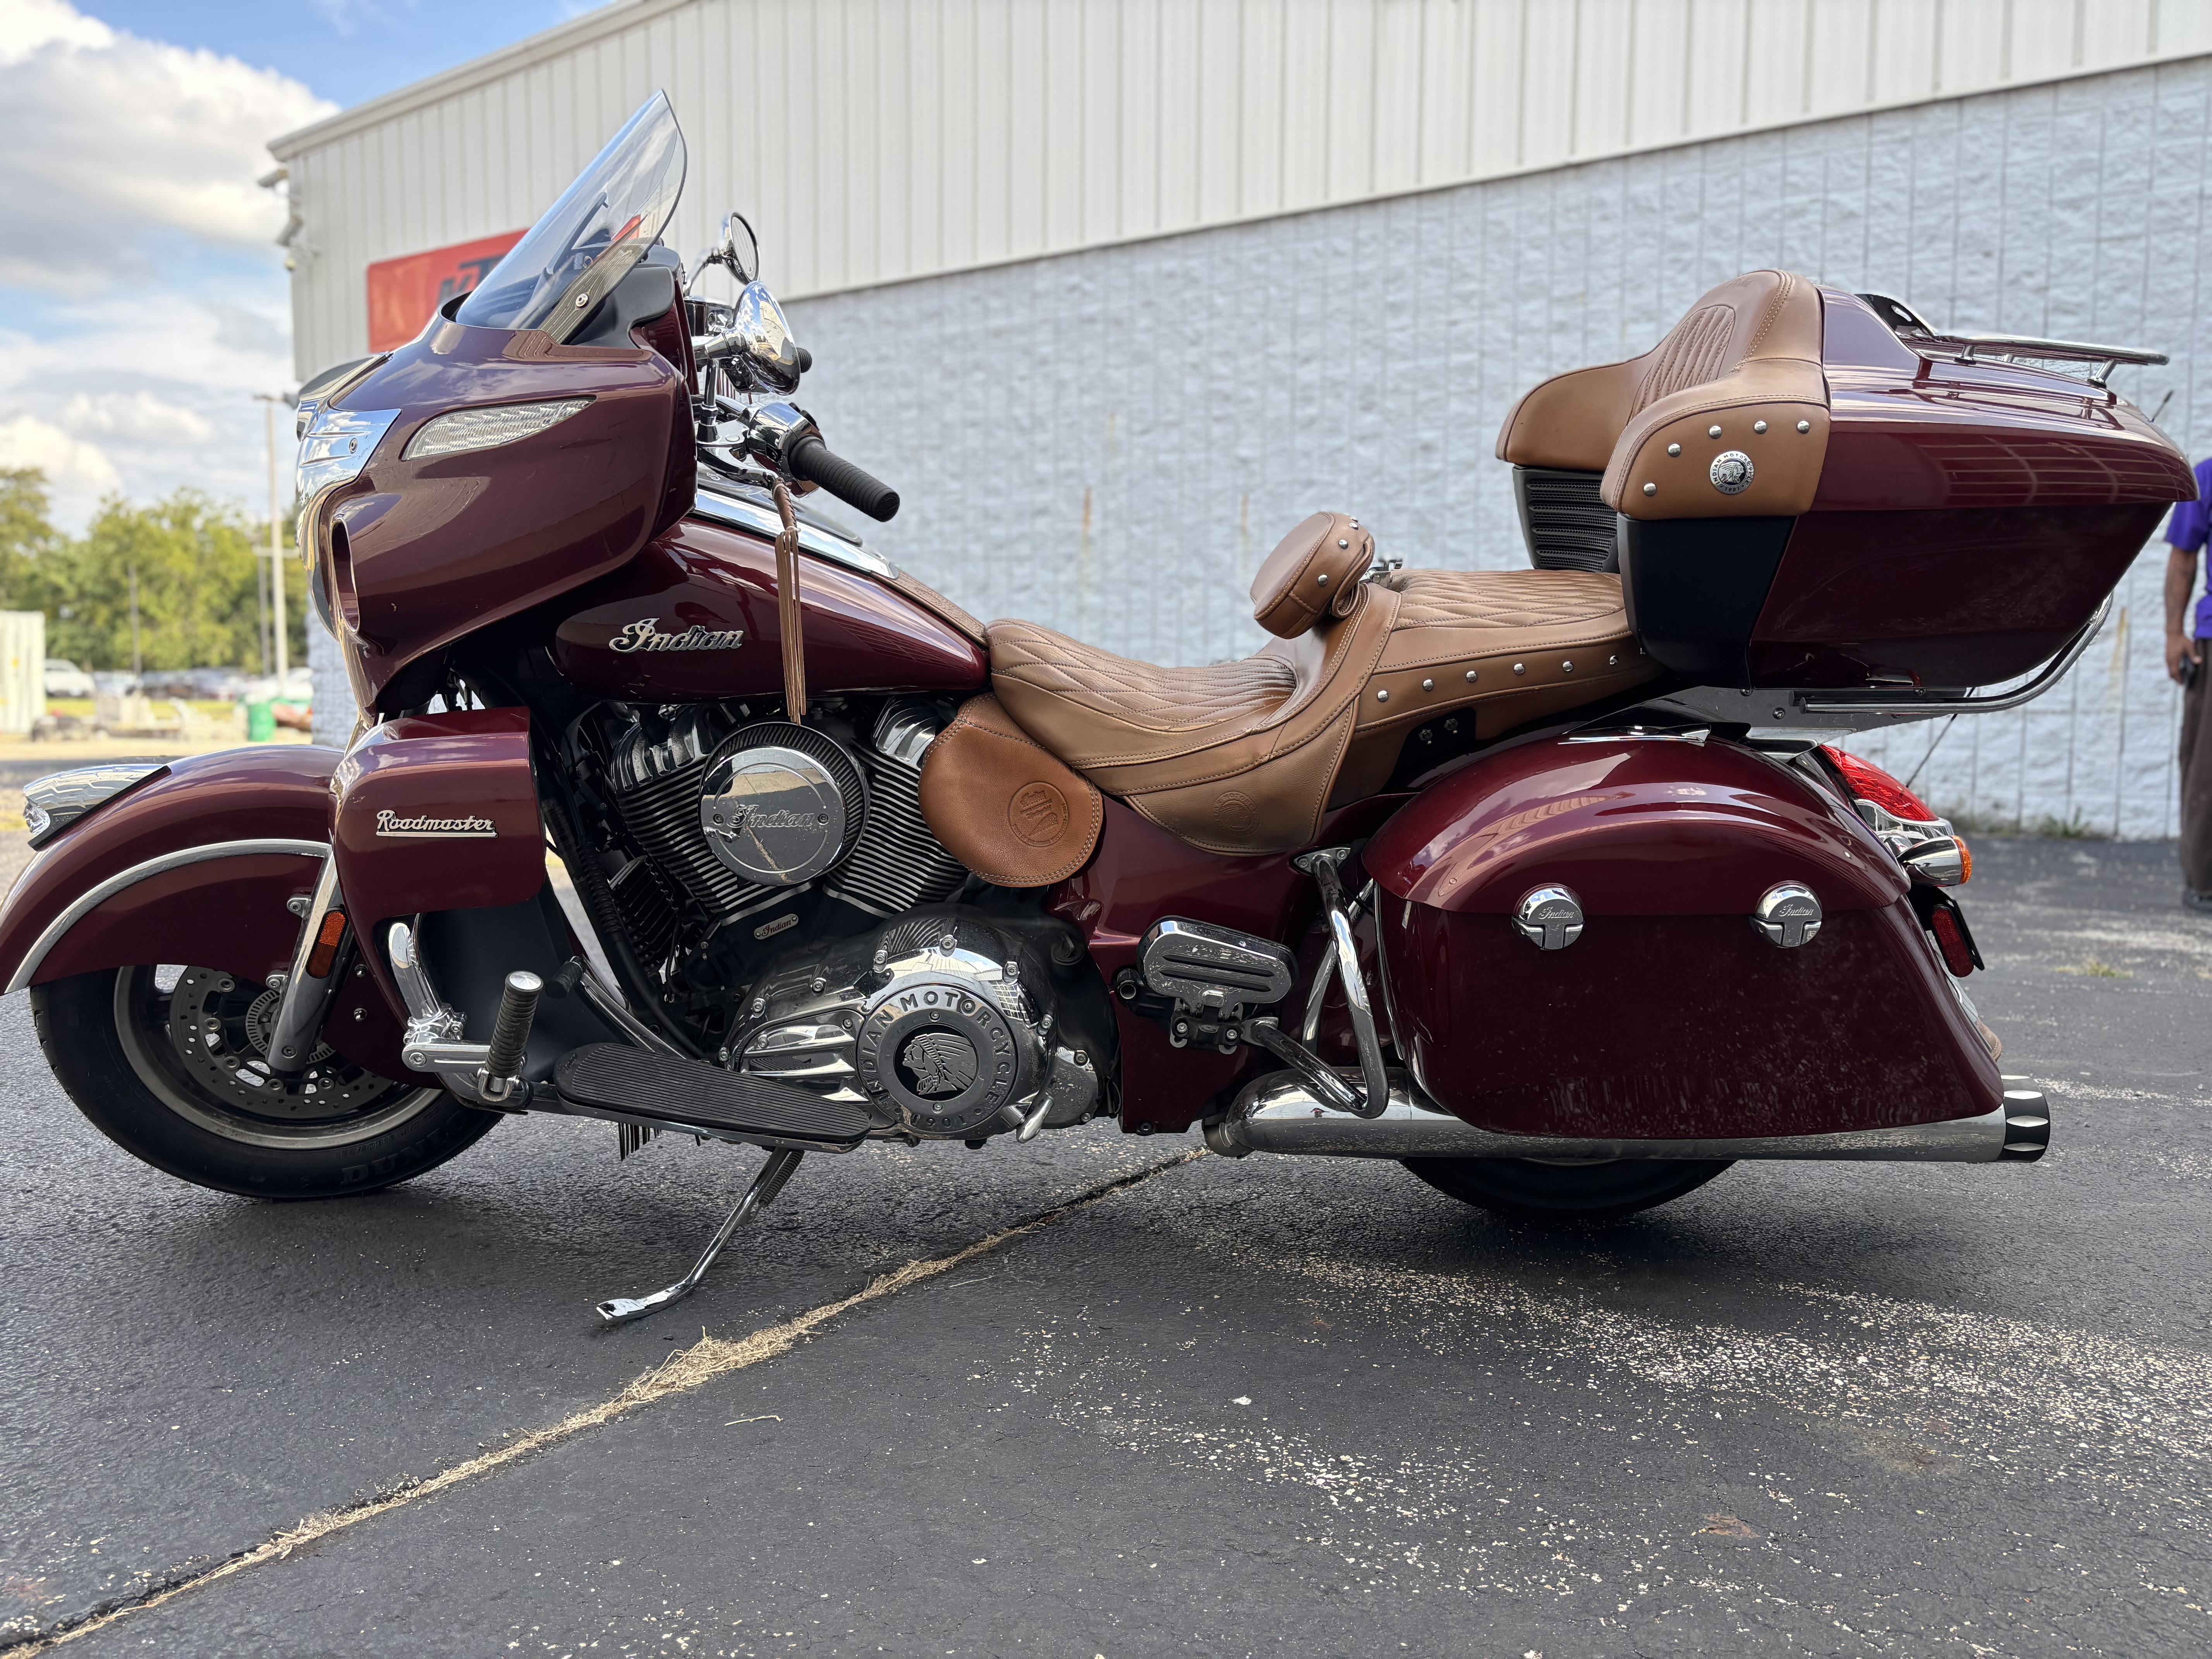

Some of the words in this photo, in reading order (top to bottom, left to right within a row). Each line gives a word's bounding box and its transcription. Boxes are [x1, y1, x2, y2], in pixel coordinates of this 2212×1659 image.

[436, 254, 504, 307] KT
[1712, 459, 1722, 485] INDIAN
[609, 618, 744, 653] Indian
[376, 810, 495, 831] Roadmaster
[726, 804, 815, 828] Indian
[1538, 907, 1574, 919] Indian
[1778, 904, 1814, 916] Indian
[761, 920, 791, 936] Indian
[862, 1009, 894, 1105] INDIAN
[900, 991, 1012, 1104] MOTORCYCLE
